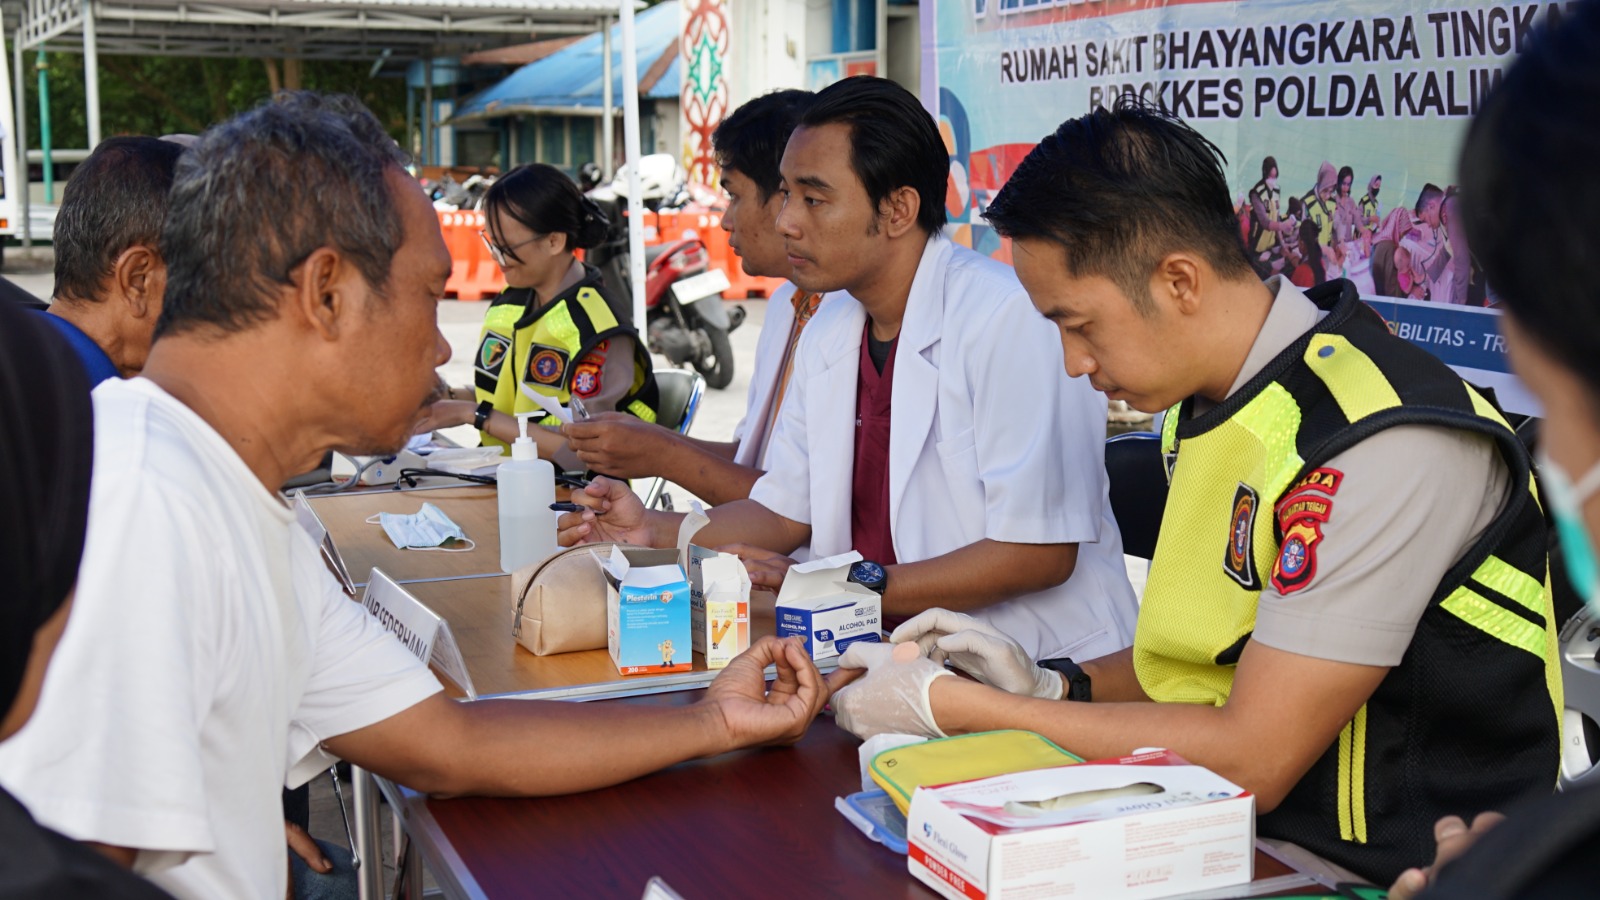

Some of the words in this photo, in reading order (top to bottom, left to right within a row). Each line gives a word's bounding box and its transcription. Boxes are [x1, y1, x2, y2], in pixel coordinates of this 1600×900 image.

[1001, 45, 1077, 83] RUMAH
[1086, 36, 1148, 77] SAKIT
[1154, 16, 1421, 71] BHAYANGKARA
[1428, 2, 1578, 57] TINGK
[1255, 74, 1384, 117] POLDA
[839, 621, 866, 631] ALCOHOL
[866, 617, 878, 626] PAD
[924, 854, 949, 880] POWDER
[949, 872, 966, 893] FREE
